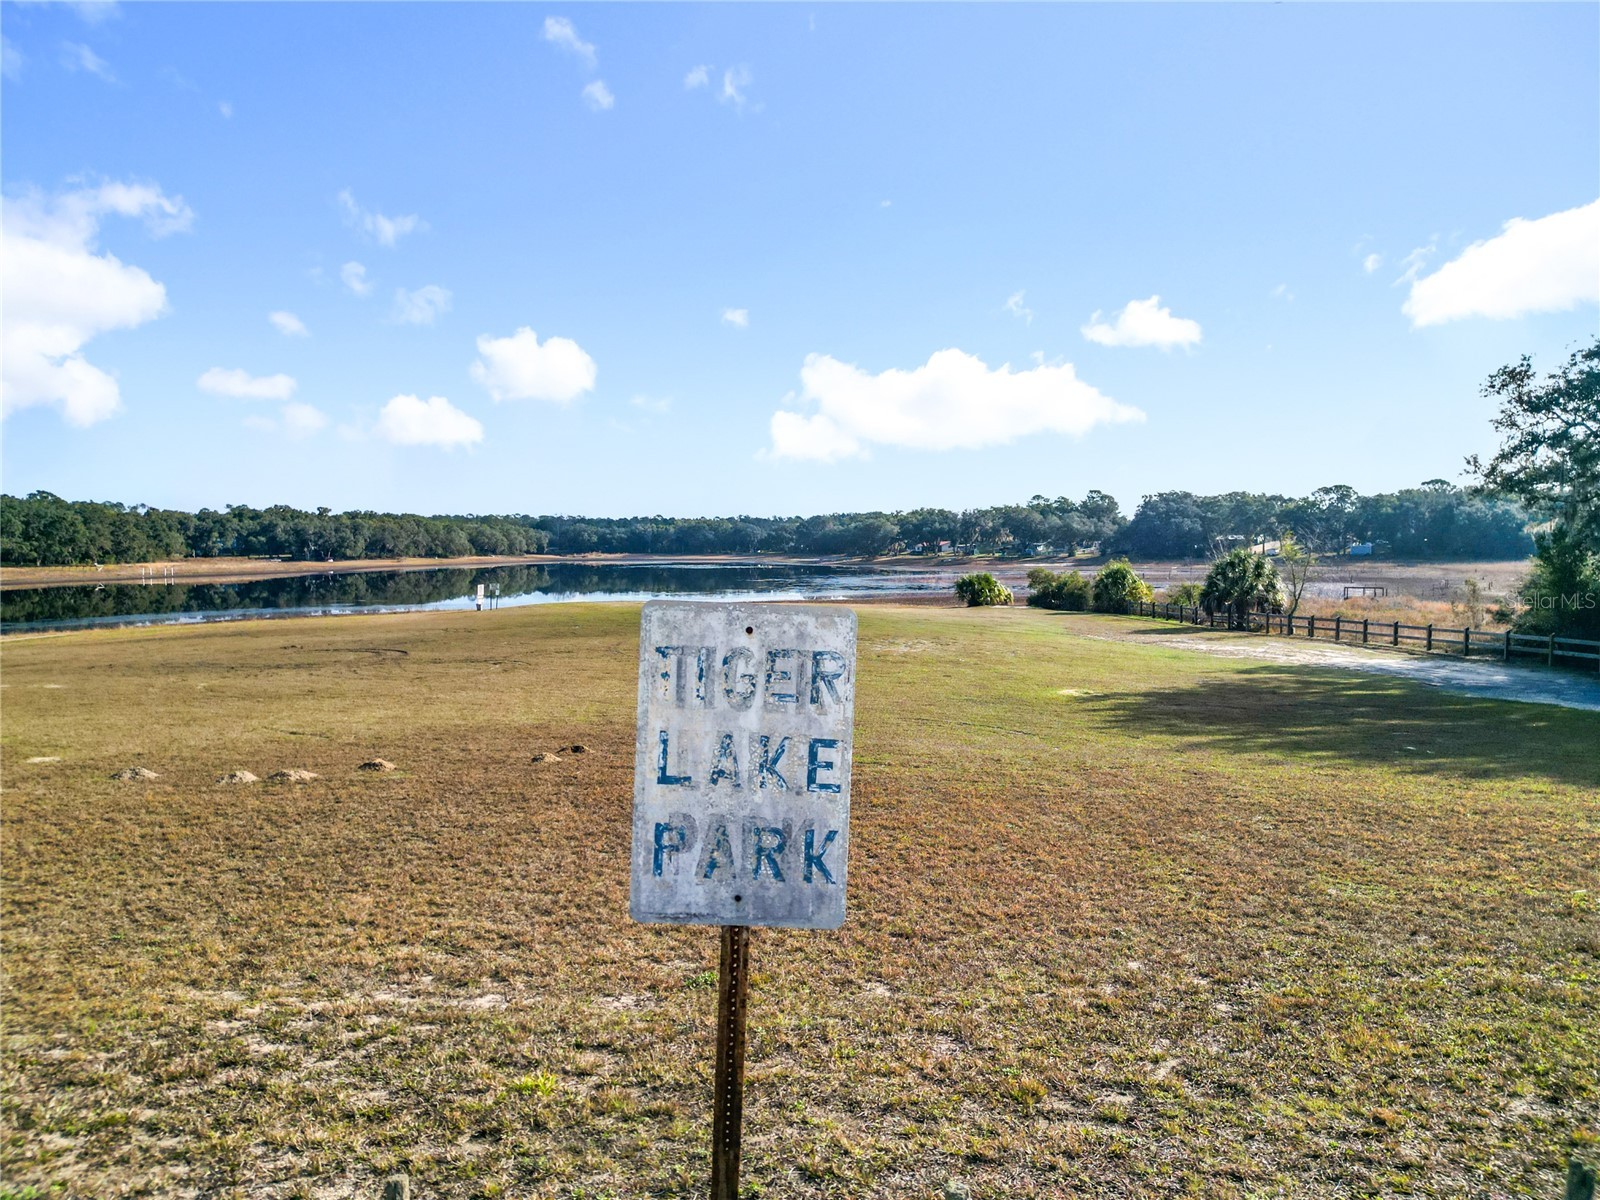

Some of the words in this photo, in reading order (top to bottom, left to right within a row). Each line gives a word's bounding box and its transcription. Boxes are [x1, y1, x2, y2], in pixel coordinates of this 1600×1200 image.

[655, 646, 846, 707] TIGER
[657, 730, 842, 793] LAKE
[653, 819, 838, 885] PARK
